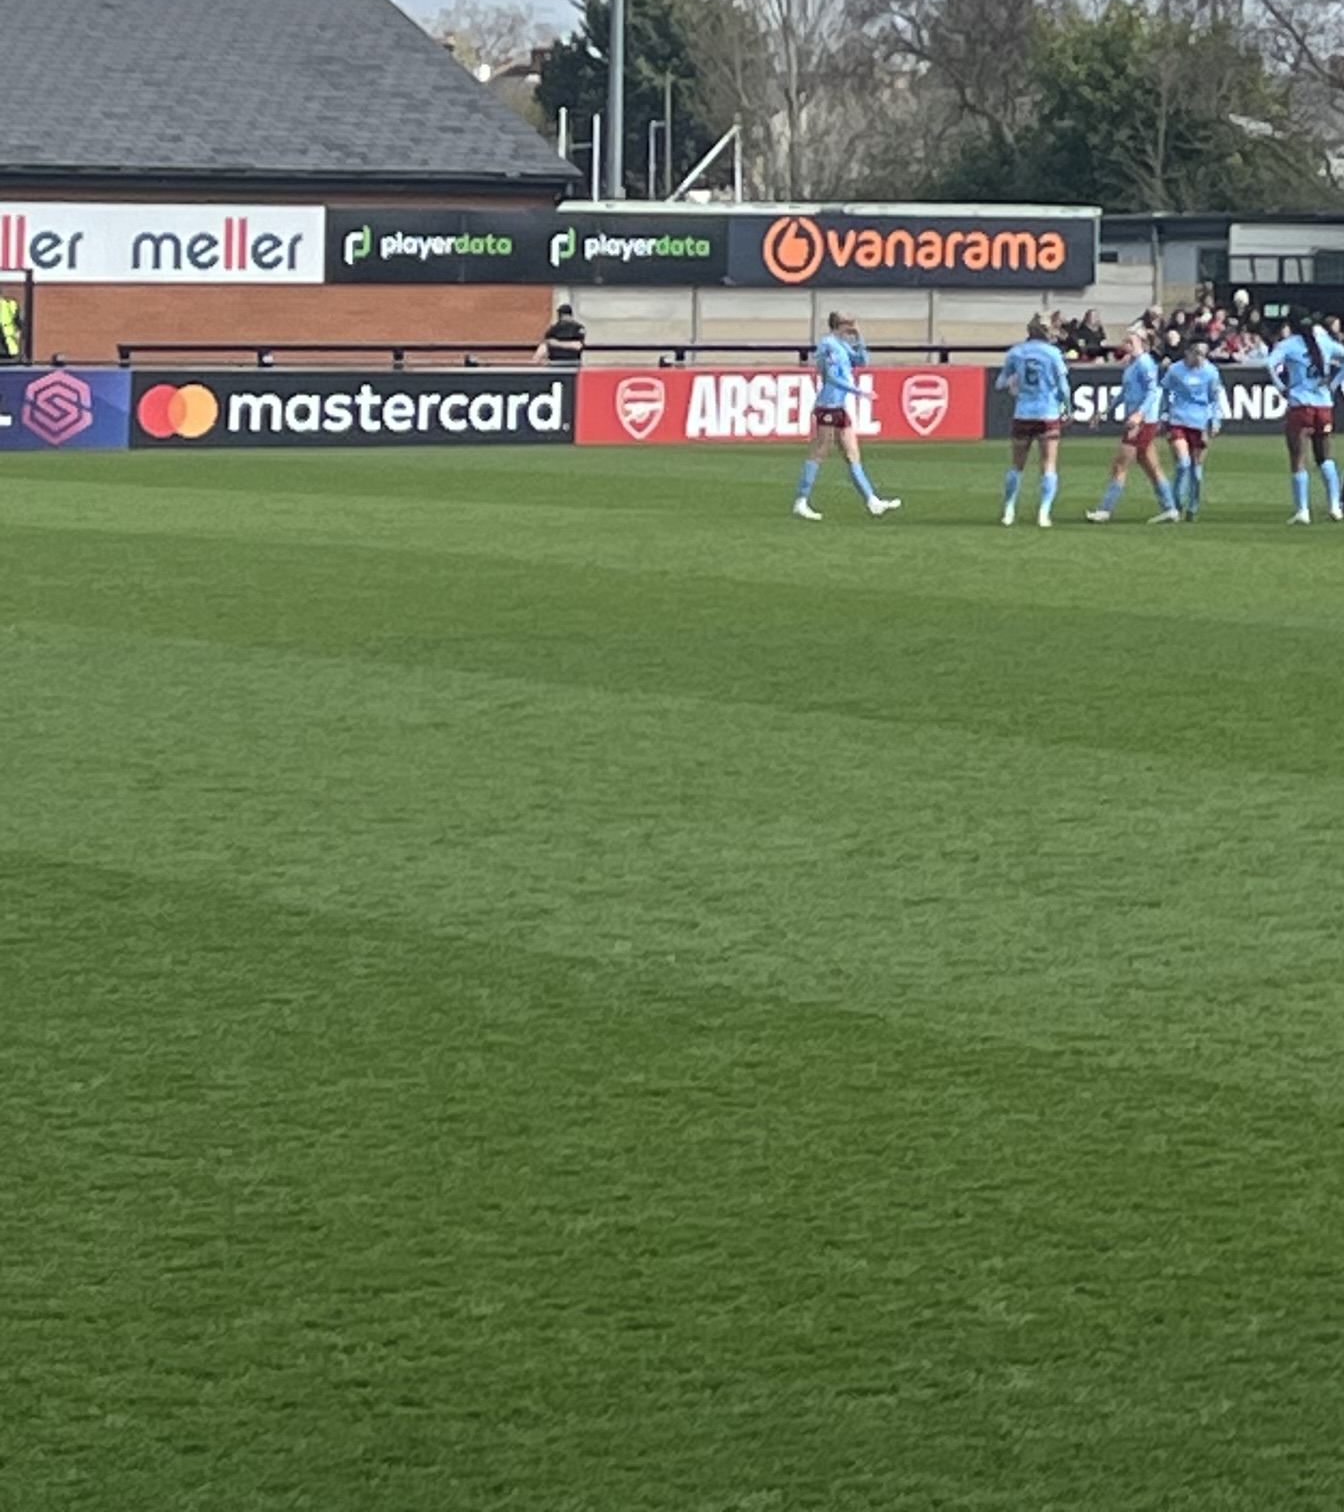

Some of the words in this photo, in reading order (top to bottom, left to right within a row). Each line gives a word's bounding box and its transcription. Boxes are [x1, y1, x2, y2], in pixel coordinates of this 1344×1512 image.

[131, 217, 303, 270] meller
[380, 231, 513, 260] playerdata
[584, 232, 710, 262] playerdata
[827, 229, 1066, 271] vanarama
[227, 381, 563, 433] mastercard
